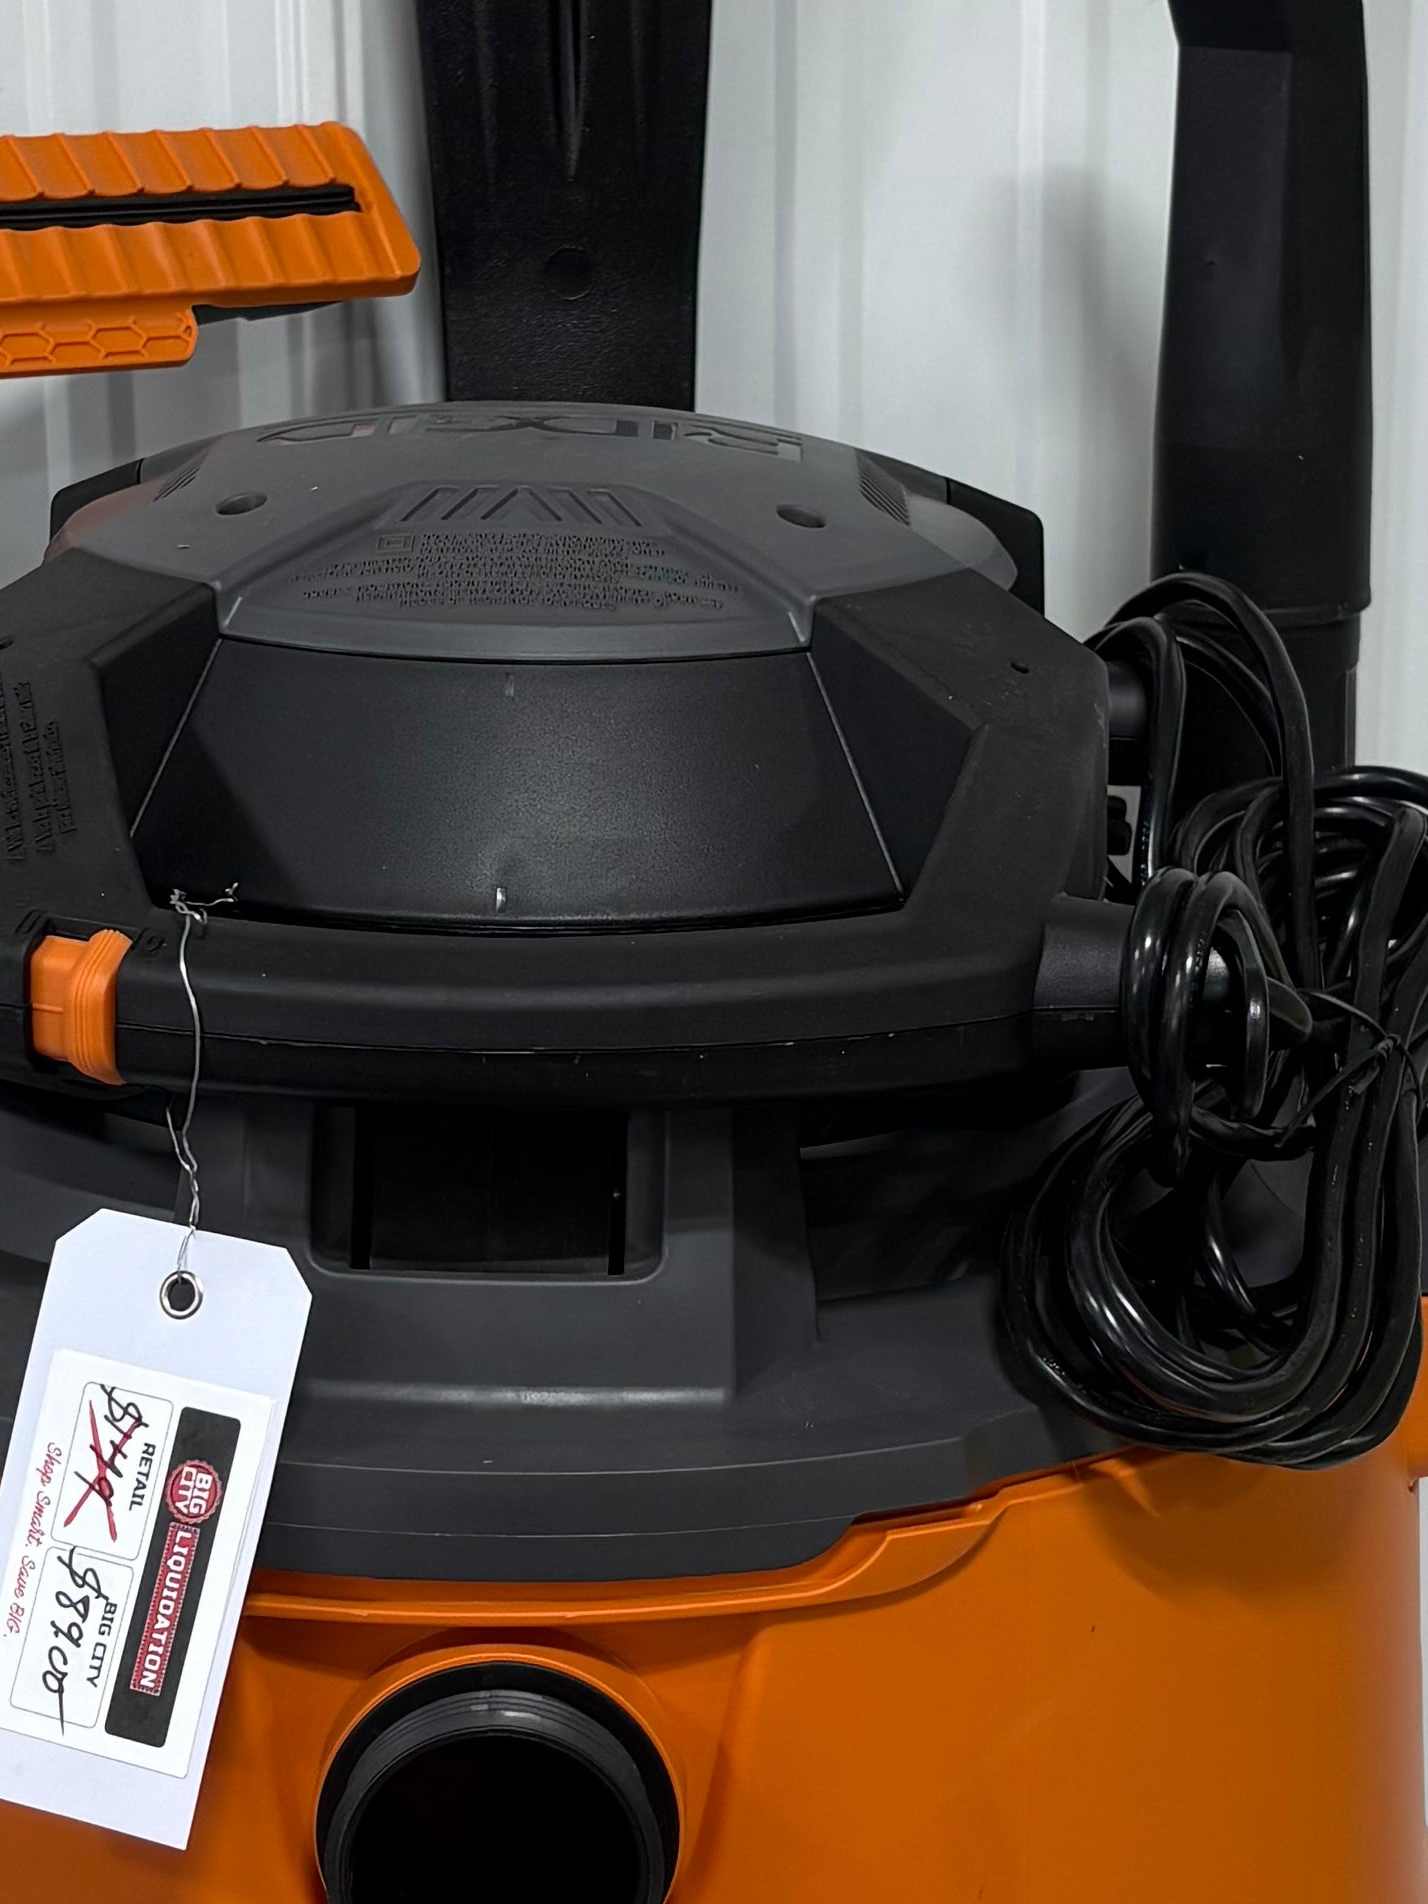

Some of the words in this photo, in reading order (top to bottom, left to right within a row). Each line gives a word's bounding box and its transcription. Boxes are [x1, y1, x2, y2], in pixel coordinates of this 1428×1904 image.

[36, 1442, 62, 1487] Shop
[129, 1442, 156, 1511] RETAIL
[175, 1466, 197, 1514] CITY
[188, 1470, 213, 1515] BIG
[25, 1490, 51, 1547] Smart.
[14, 1555, 36, 1598] Save
[3, 1602, 25, 1637] BIG.
[98, 1601, 118, 1636] BIG
[140, 1530, 192, 1688] LIQUIDATION
[86, 1642, 107, 1688] CITY
